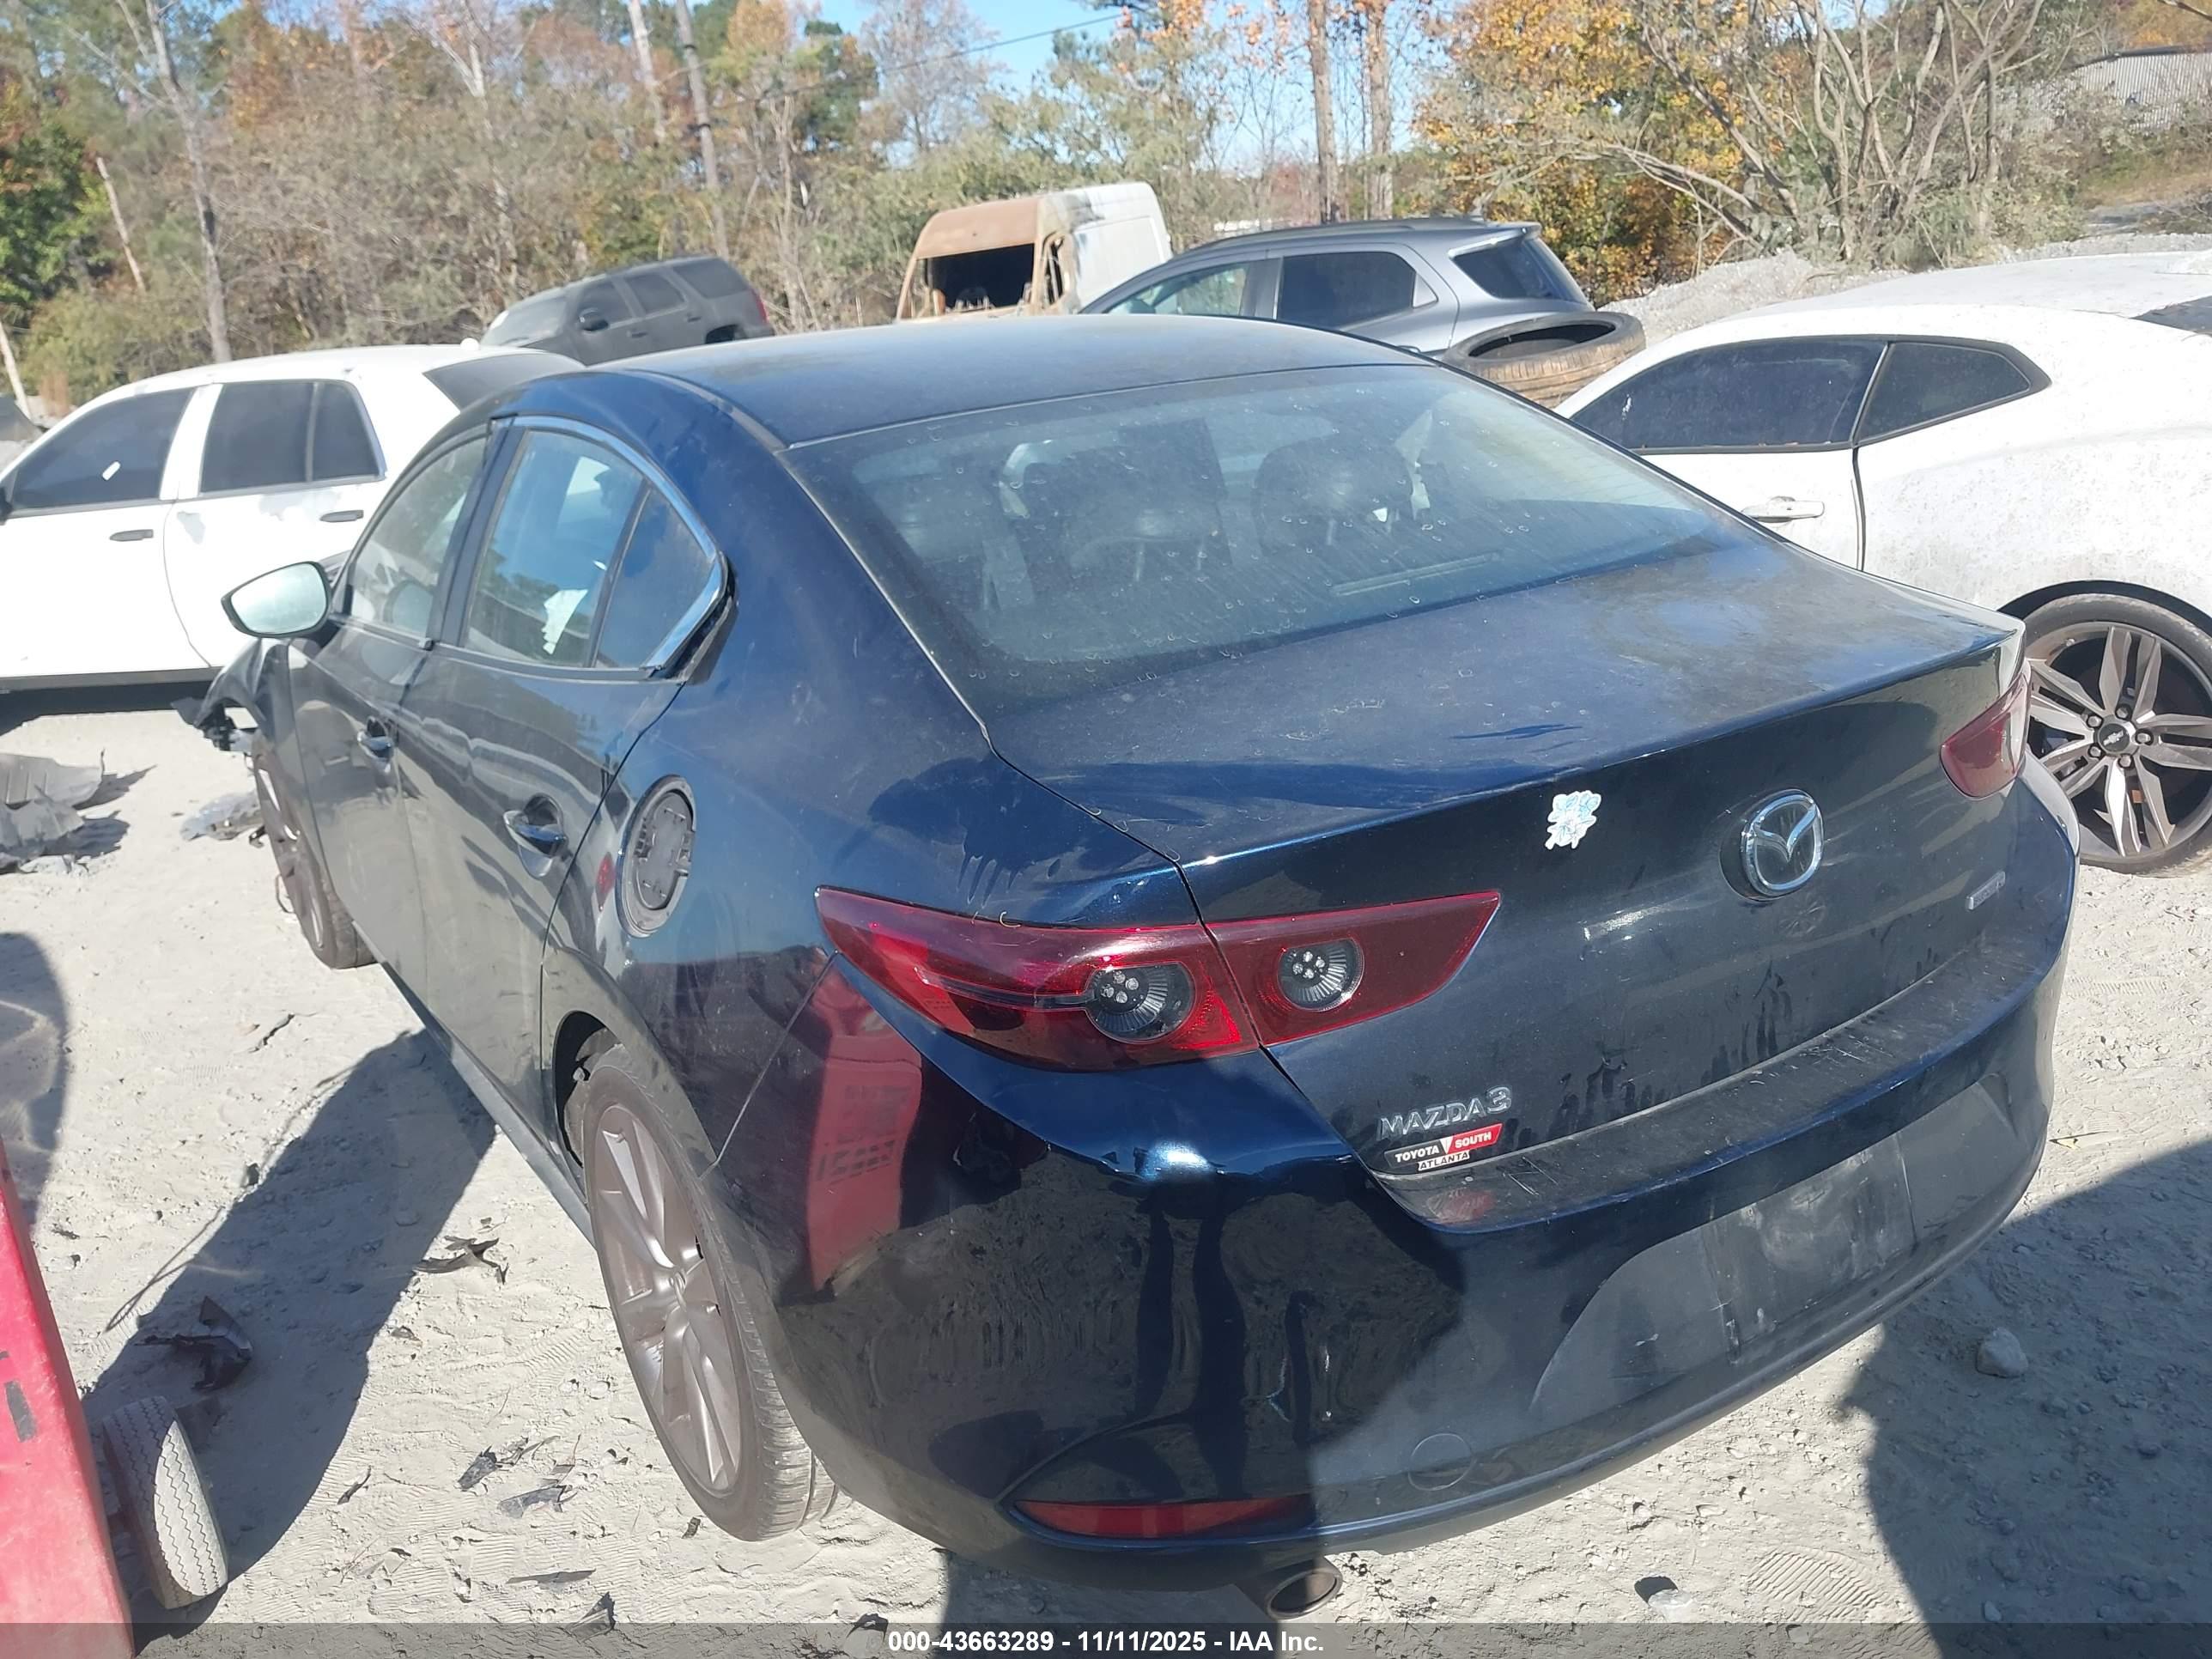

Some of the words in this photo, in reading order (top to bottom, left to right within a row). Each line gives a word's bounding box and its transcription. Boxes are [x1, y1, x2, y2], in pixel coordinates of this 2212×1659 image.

[1376, 1086, 1512, 1140] MAZDA3
[1395, 1146, 1440, 1163] TOYOTA
[1455, 1131, 1492, 1149] SOUTH
[1419, 1151, 1470, 1170] ATLANTA
